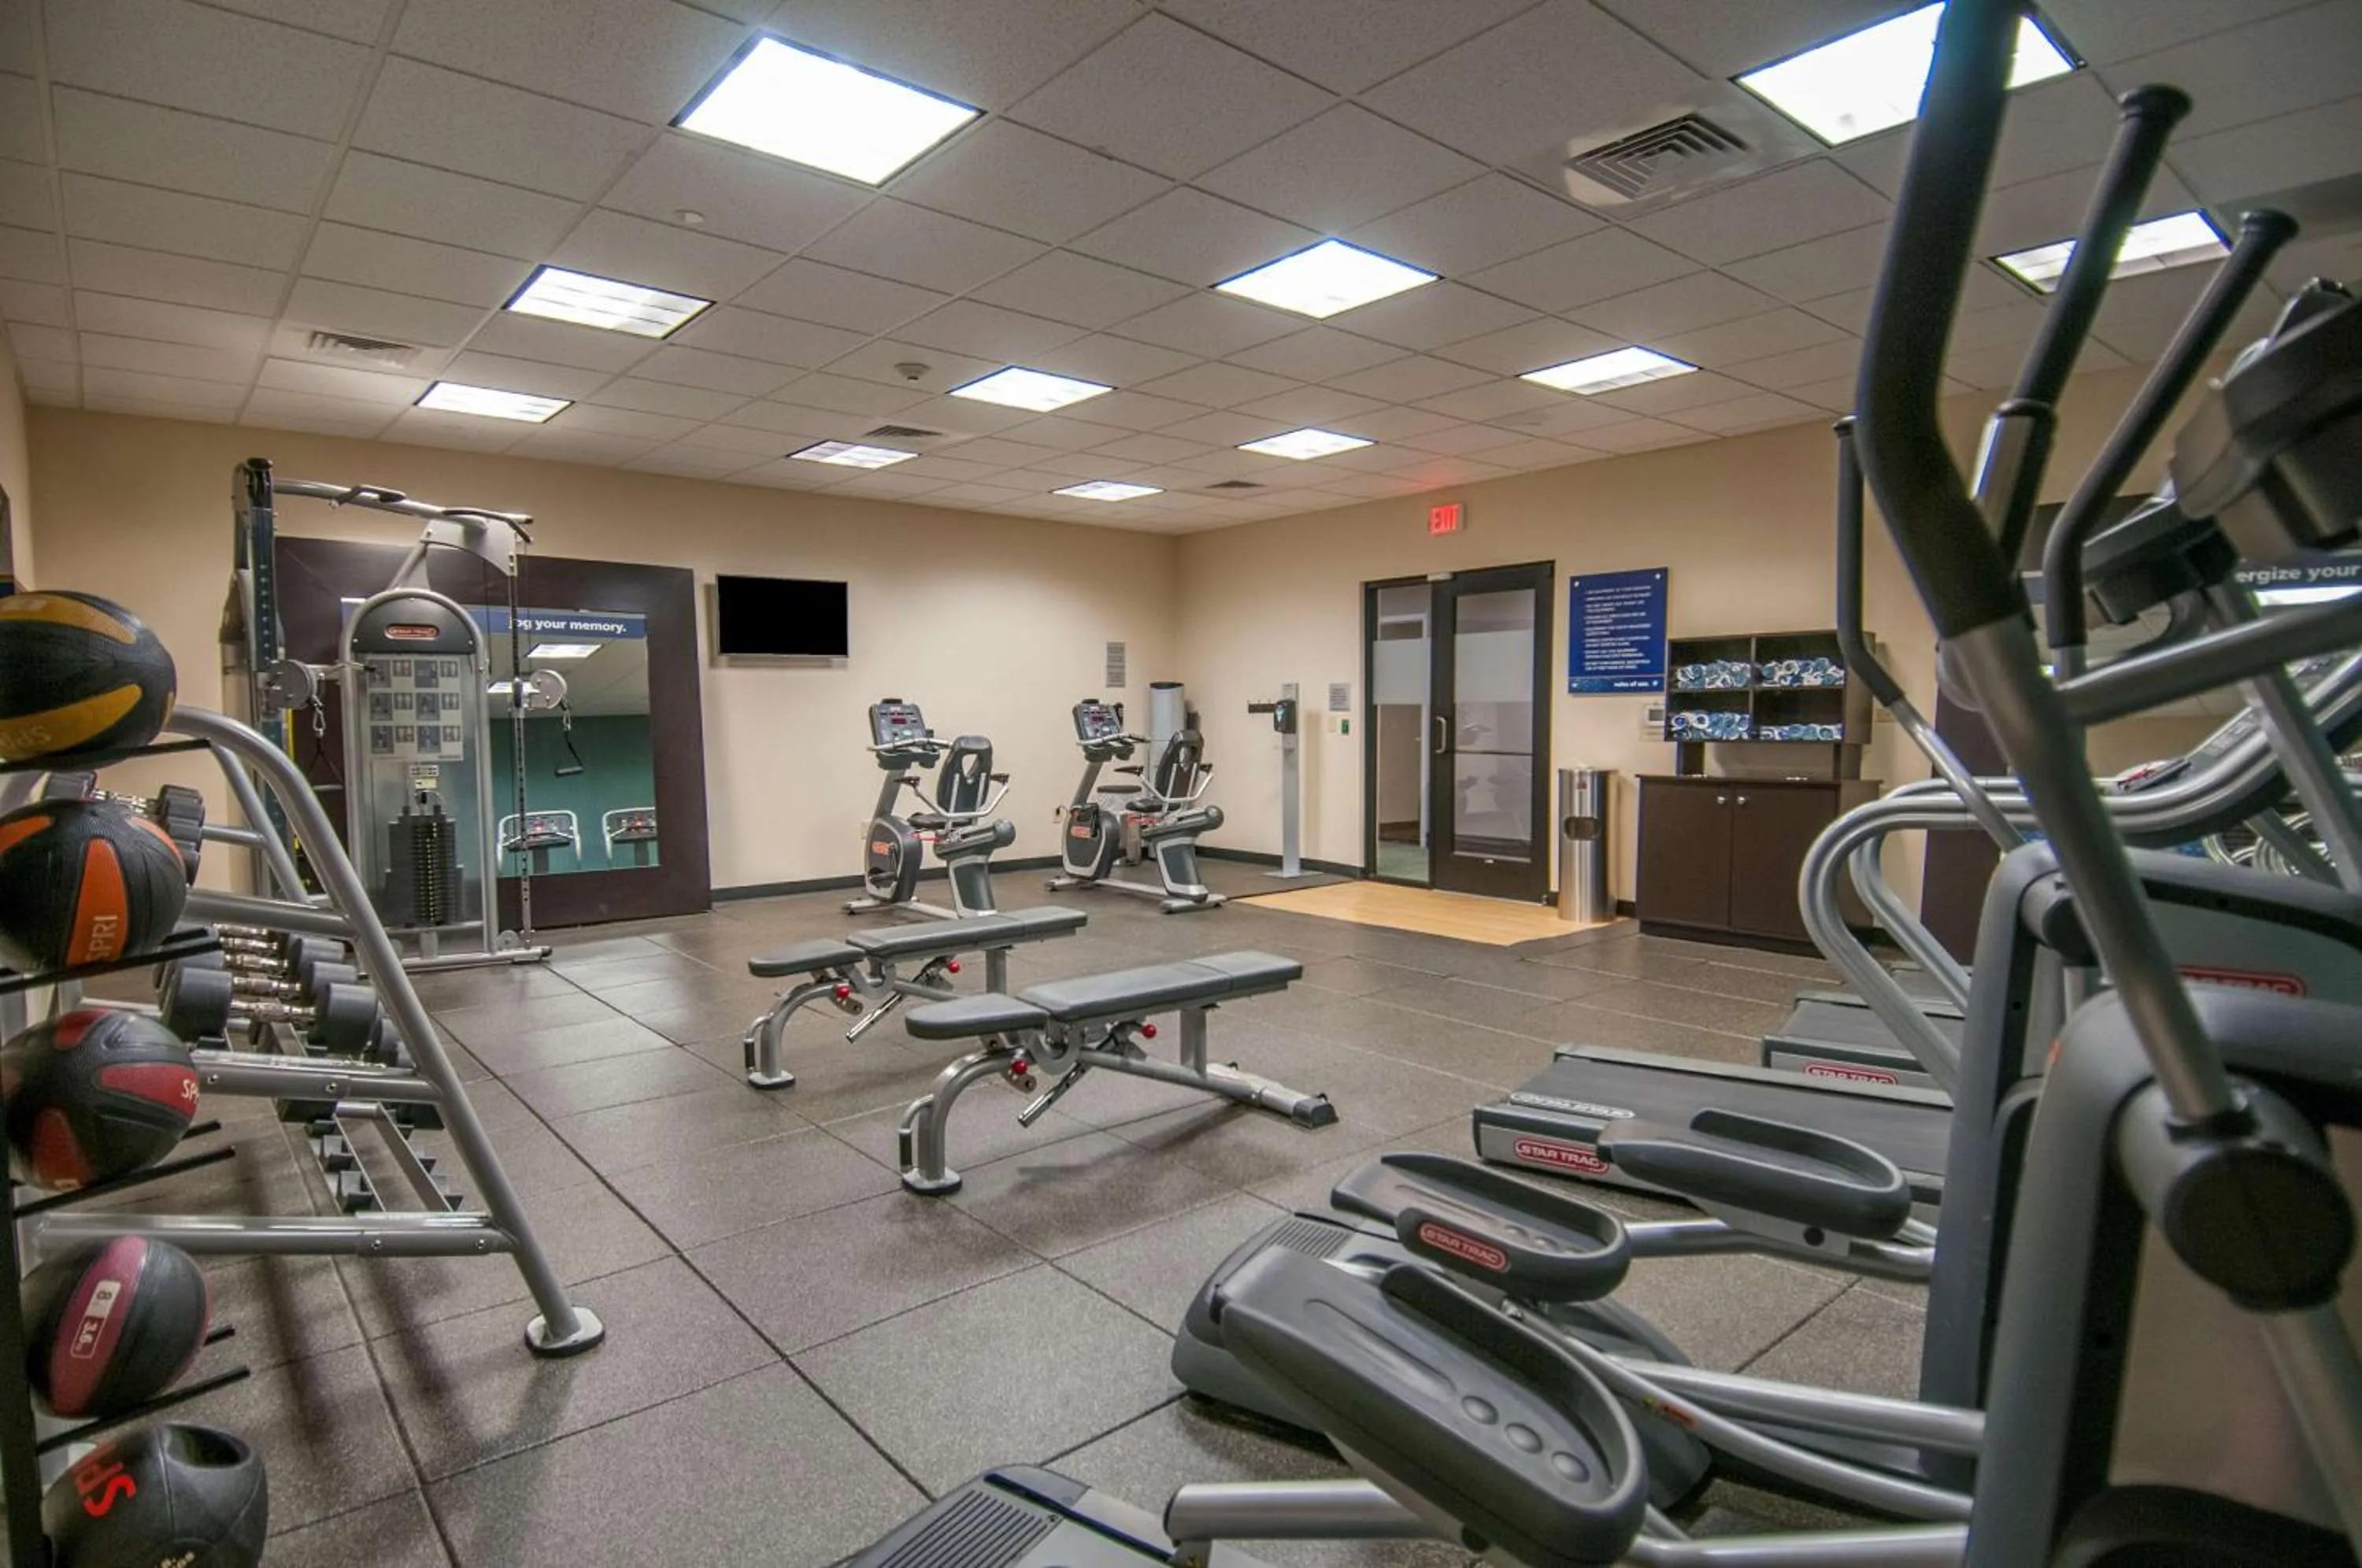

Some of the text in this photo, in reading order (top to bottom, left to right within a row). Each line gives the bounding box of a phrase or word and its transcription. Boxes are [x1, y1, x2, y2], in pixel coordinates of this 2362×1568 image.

[1431, 504, 1459, 534] EXIT
[2307, 564, 2361, 582] your
[535, 619, 566, 631] your
[569, 621, 627, 634] memory.
[85, 914, 118, 962] SPRI
[1520, 1145, 1601, 1167] STAR TRAC
[1425, 1228, 1499, 1264] STAR TRAC
